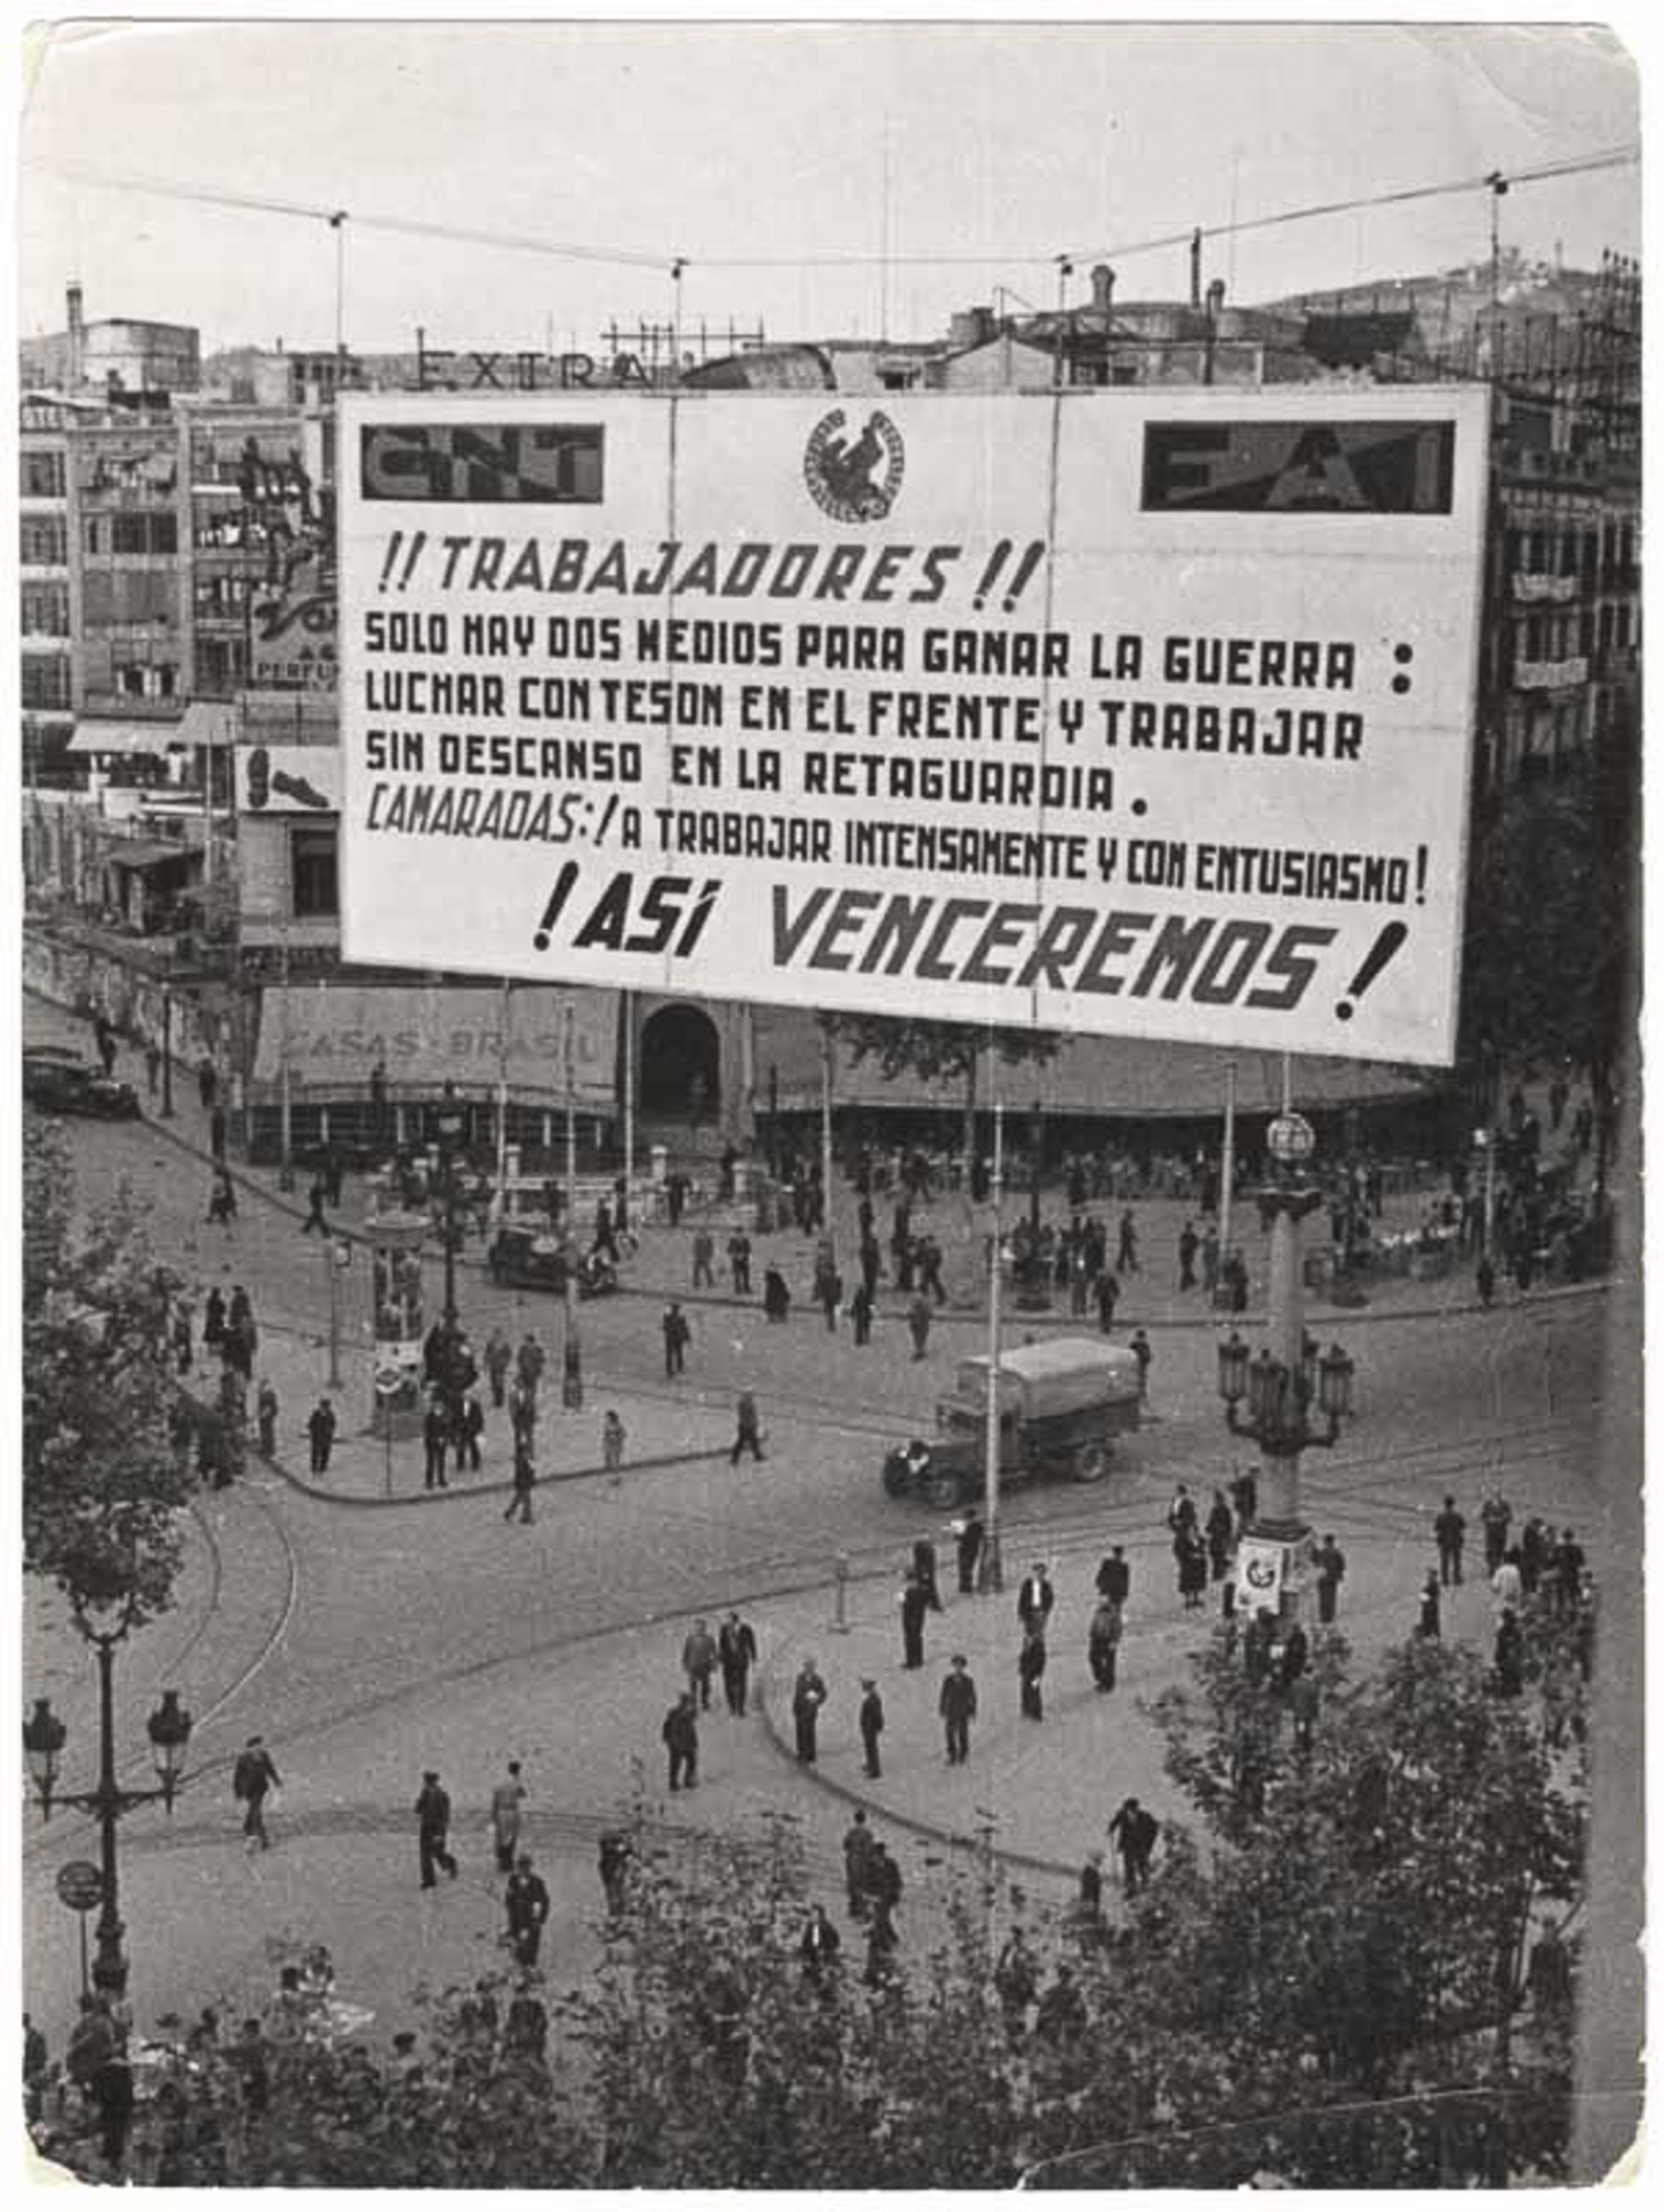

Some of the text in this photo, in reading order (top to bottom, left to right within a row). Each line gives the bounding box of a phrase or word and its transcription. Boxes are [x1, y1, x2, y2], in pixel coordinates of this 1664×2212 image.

[419, 351, 653, 391] EXTRA
[364, 428, 596, 499] CNT
[366, 611, 447, 654] SOLO
[464, 615, 534, 657] HAY
[548, 617, 620, 661] DOS
[638, 618, 781, 666] MEDIOS
[797, 625, 904, 672] PARA
[924, 628, 1070, 678] GANAR
[1092, 634, 1142, 680] LA
[1164, 636, 1354, 689] GUERRA
[366, 671, 1363, 760] LUCHAR CON TESON EN EL FRENTE Y TRABAJAR
[367, 730, 423, 772] SIN
[440, 733, 641, 782] DESCANSO
[671, 745, 720, 787] EN
[739, 749, 780, 791] LA
[656, 809, 831, 863] TRABAJAR
[846, 821, 1088, 879] INTENSAMENTE
[1098, 838, 1117, 882] Y
[1127, 840, 1186, 888] CON
